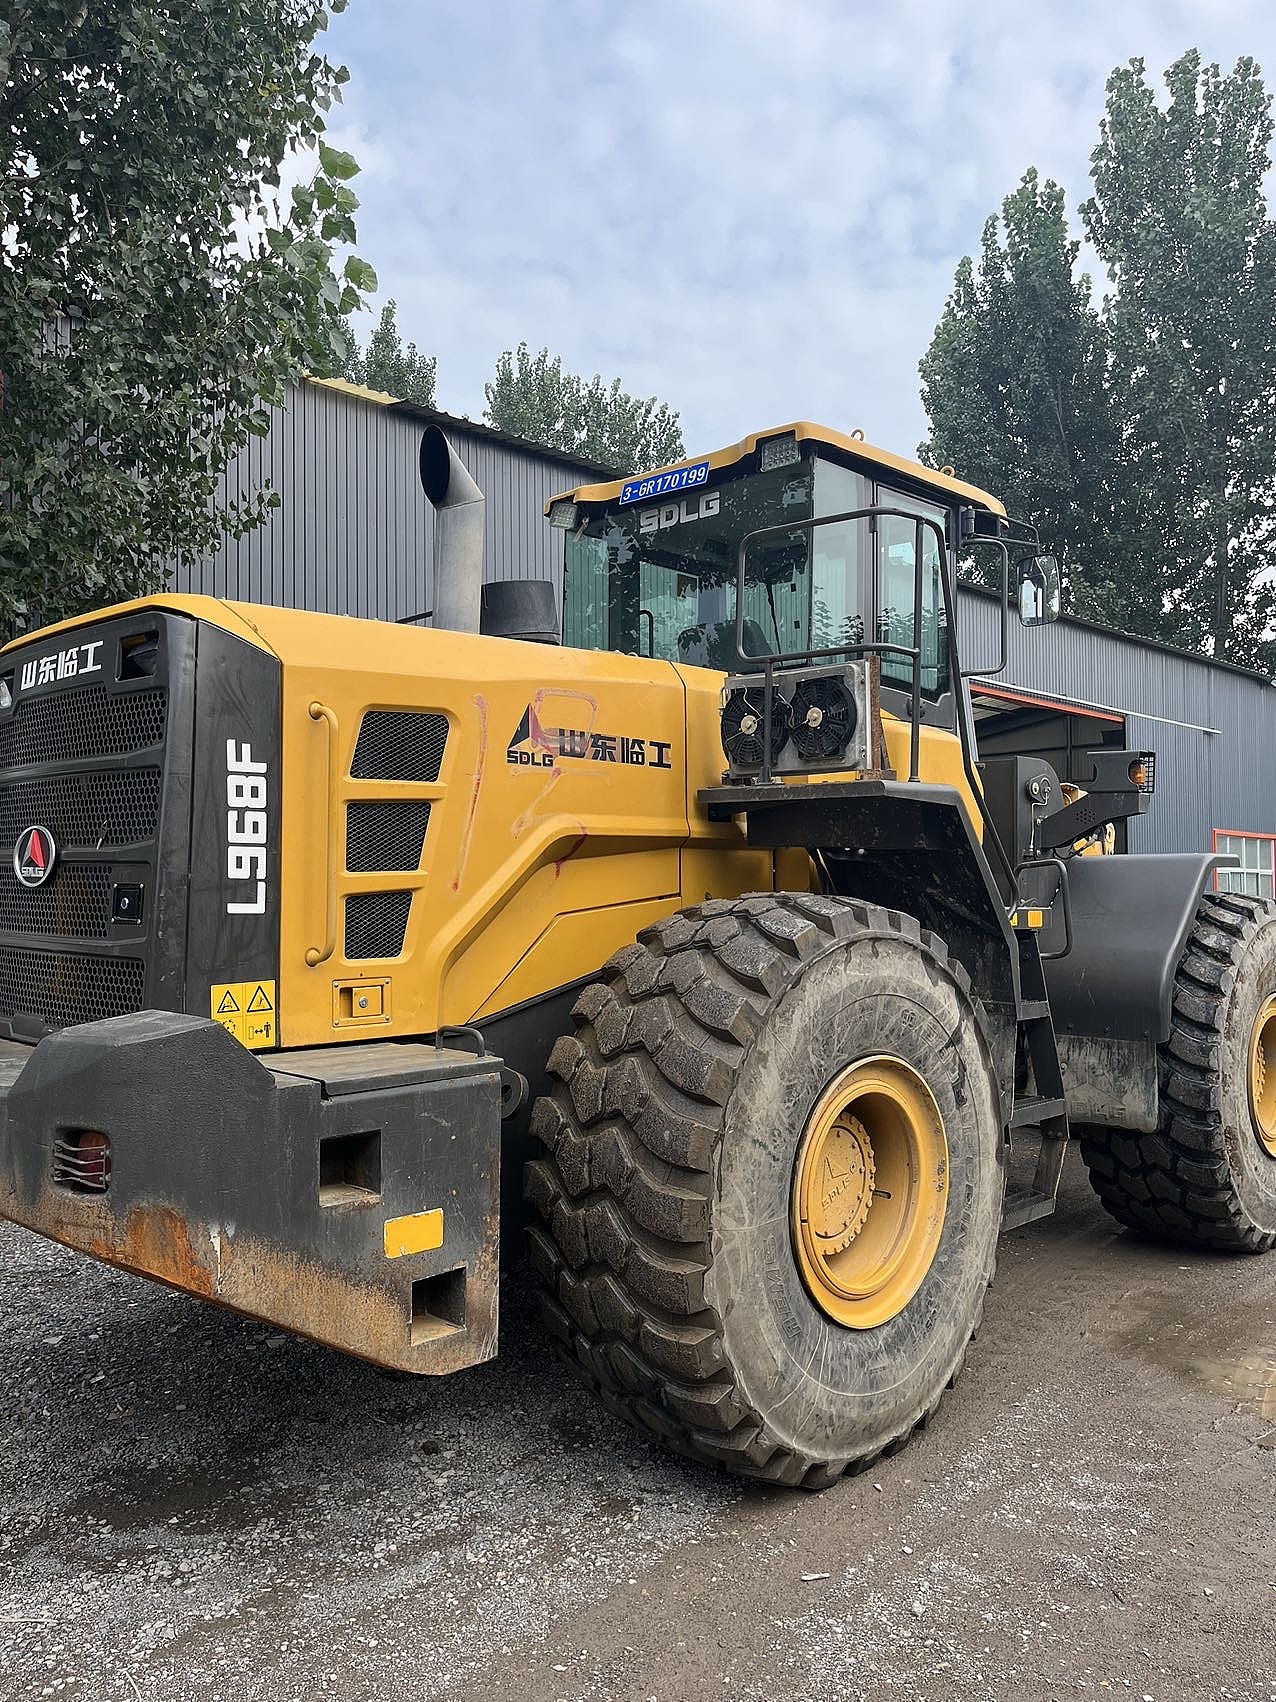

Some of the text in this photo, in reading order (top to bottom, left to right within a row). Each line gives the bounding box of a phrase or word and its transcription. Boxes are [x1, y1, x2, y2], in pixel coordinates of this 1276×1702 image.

[640, 491, 720, 533] SDLG
[20, 640, 104, 690] 山东临工
[506, 750, 553, 767] SDLG
[558, 728, 672, 769] 山东临工
[226, 738, 268, 915] L968F
